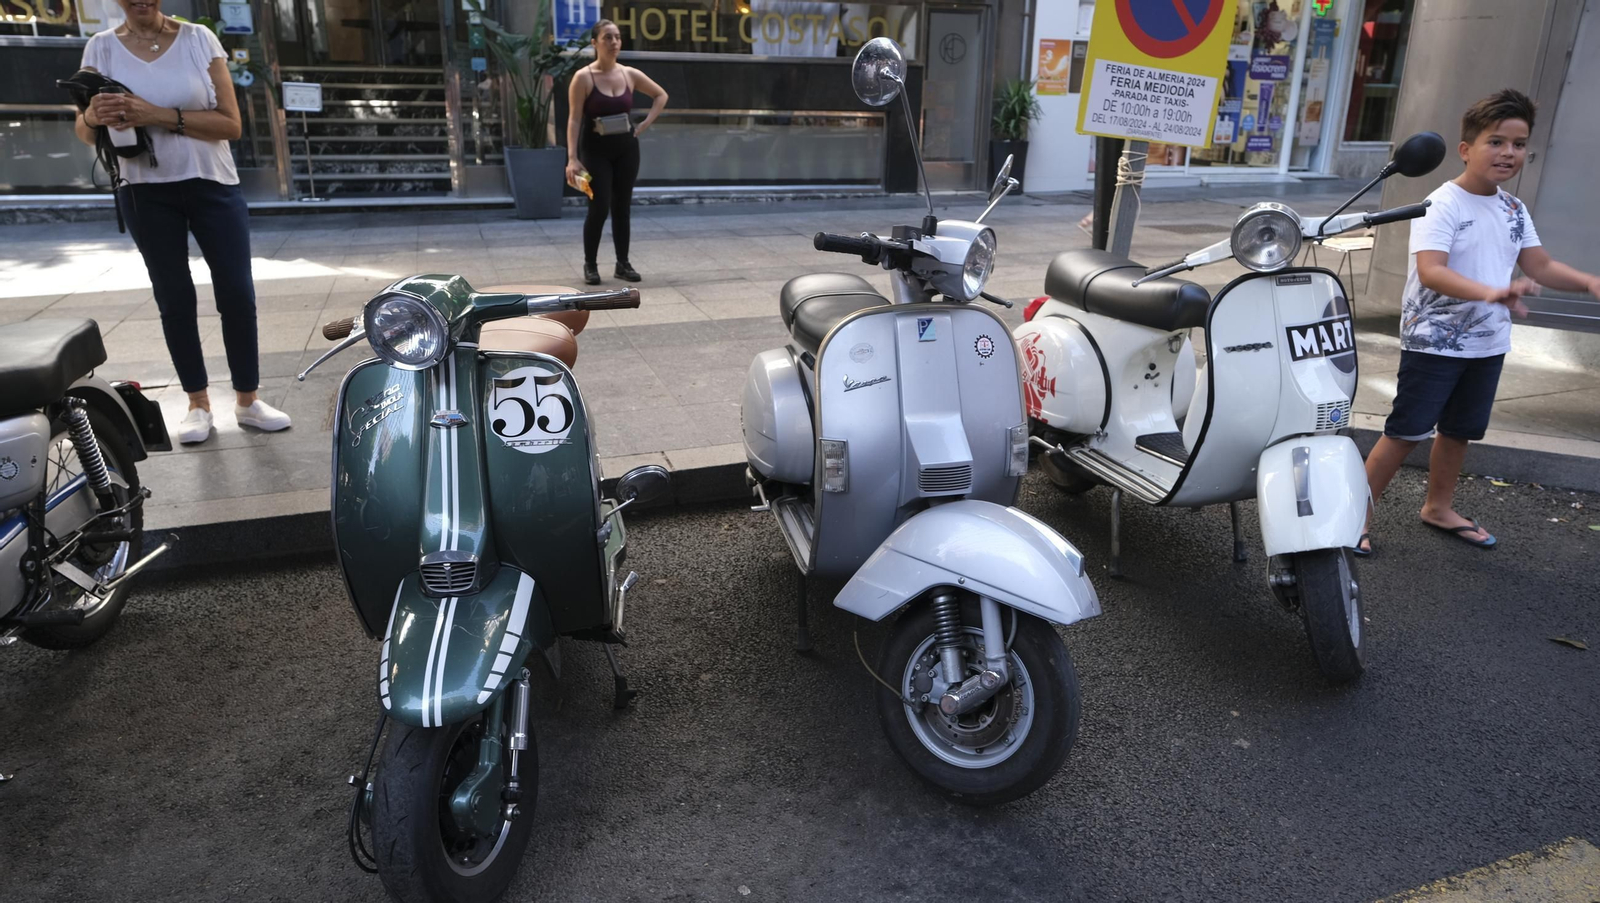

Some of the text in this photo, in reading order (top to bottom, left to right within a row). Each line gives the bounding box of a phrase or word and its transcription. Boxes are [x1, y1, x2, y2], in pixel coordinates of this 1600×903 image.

[0, 0, 101, 24] SOL
[612, 7, 906, 47] HOTEL COSTASOL
[1105, 63, 1206, 88] FERIA DE ALMERIA 2024
[1110, 75, 1195, 98] FERIA MEDIODÍA
[1111, 89, 1149, 102] -PARADA
[1150, 94, 1163, 104] DE
[1102, 98, 1193, 123] DE 10:00h a 19:00h
[1091, 112, 1107, 124] DEL
[1109, 115, 1147, 129] 17/08/2024
[1151, 122, 1162, 132] AL
[1163, 123, 1202, 137] 24/08/2024
[492, 374, 574, 438] 55
